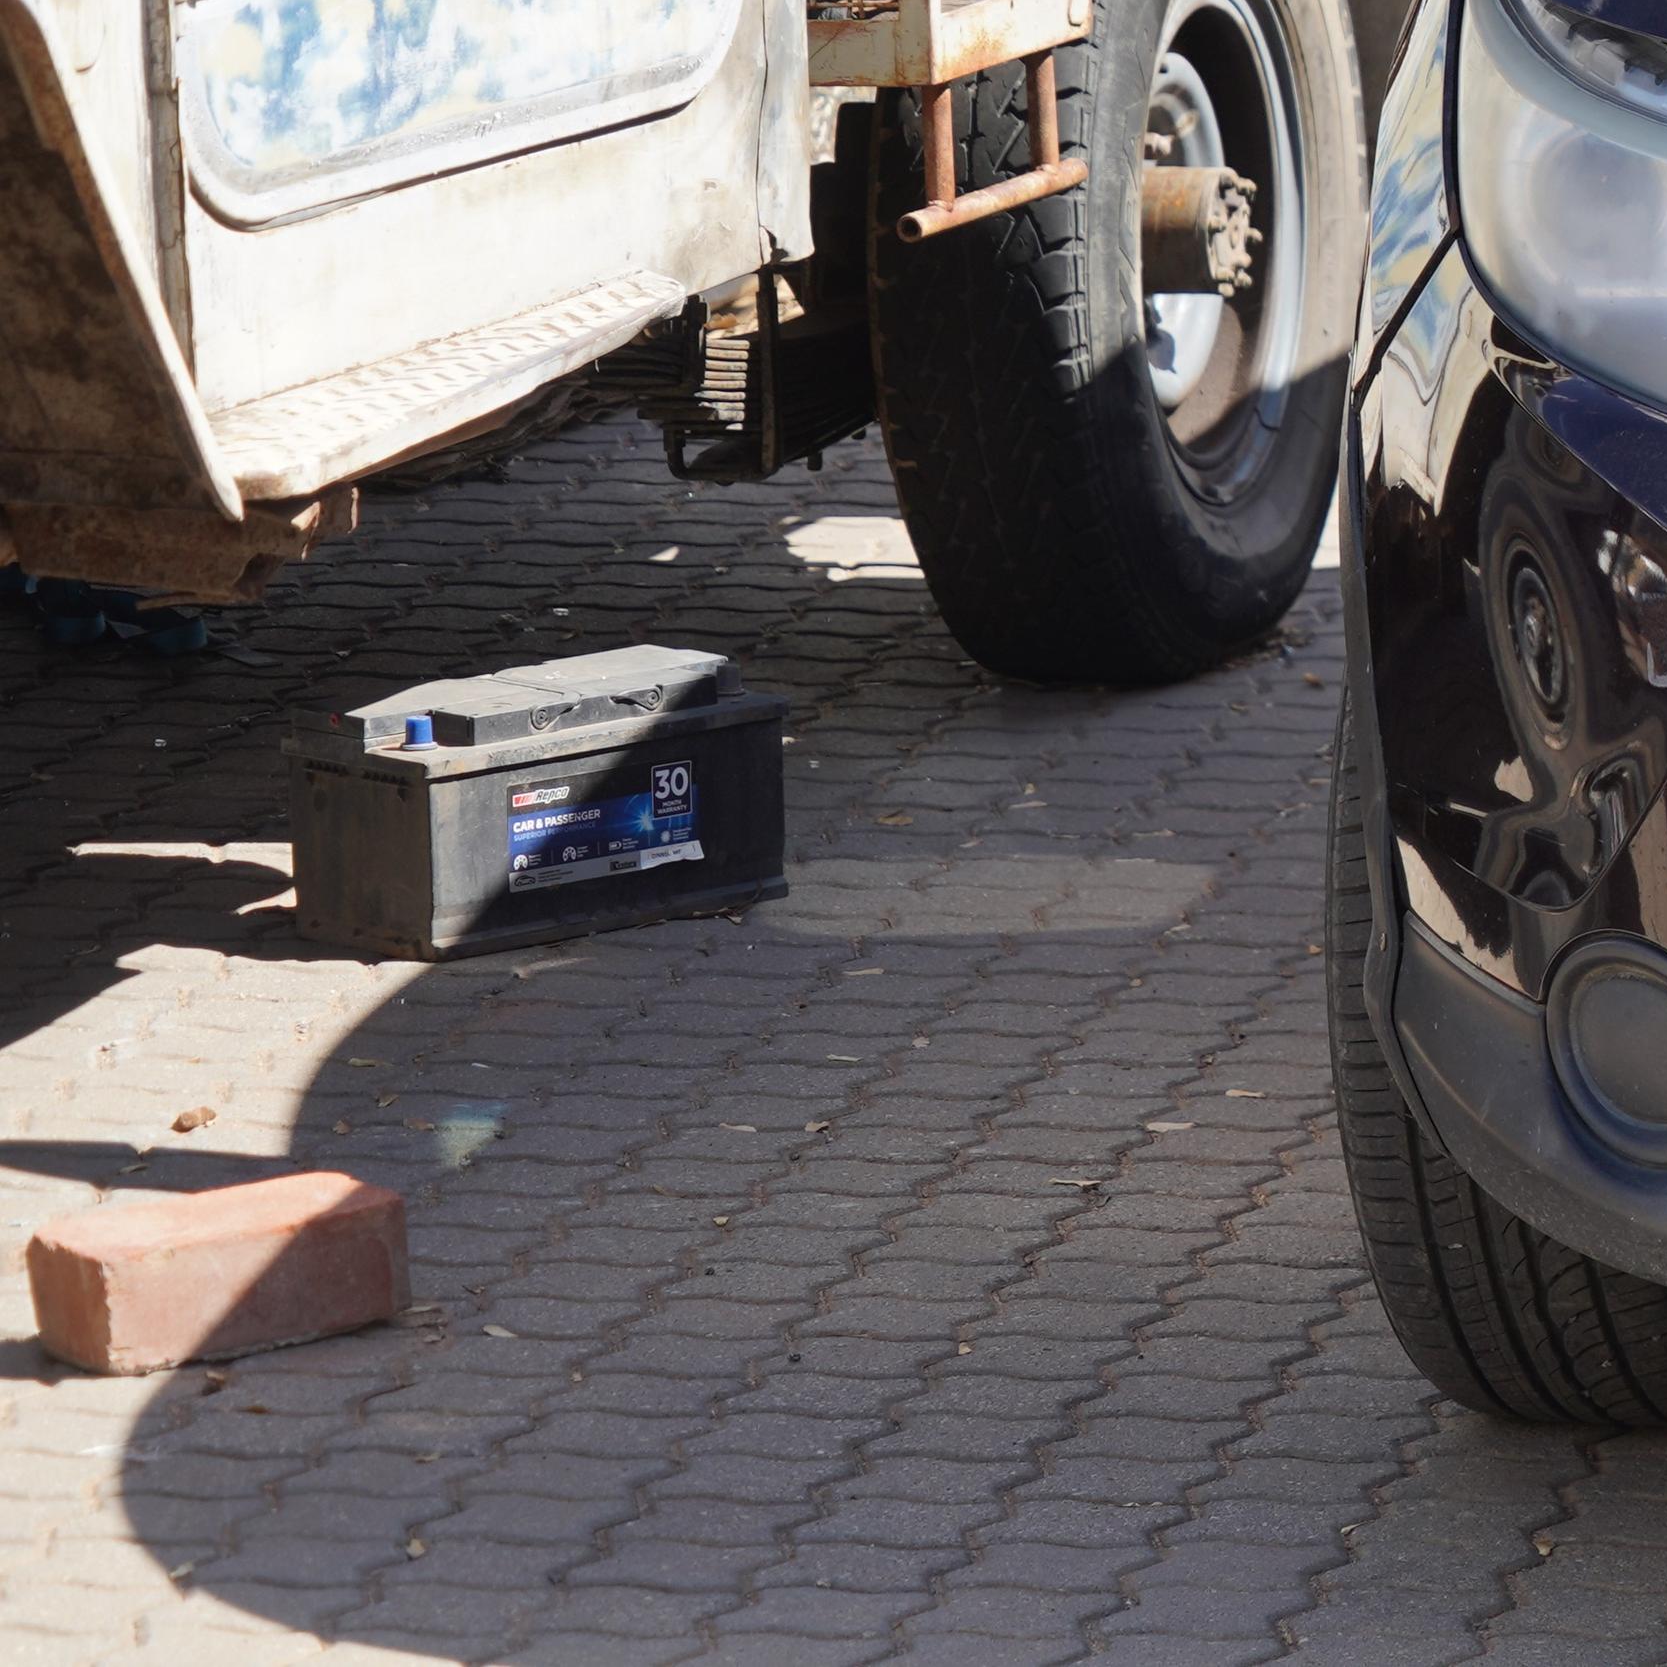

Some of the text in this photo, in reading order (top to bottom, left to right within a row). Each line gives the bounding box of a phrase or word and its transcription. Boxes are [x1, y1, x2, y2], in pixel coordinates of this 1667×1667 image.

[535, 786, 569, 804] Repco
[655, 766, 689, 800] 30
[513, 808, 601, 833] CAR & PASSENGER
